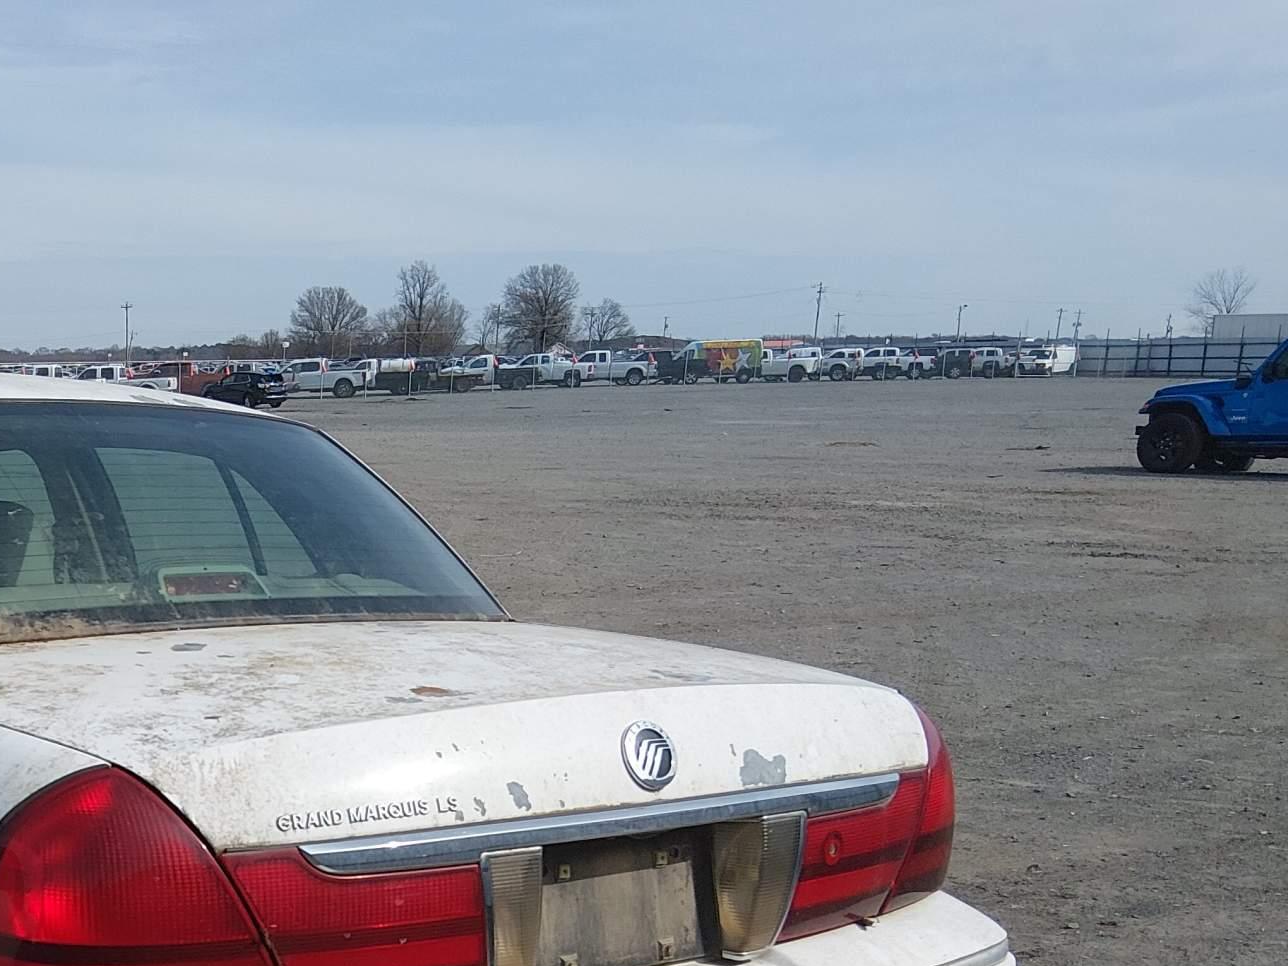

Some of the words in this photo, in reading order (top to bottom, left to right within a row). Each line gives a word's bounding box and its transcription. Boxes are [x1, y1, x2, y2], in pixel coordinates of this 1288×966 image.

[275, 809, 343, 832] GRAND
[346, 799, 429, 824] MARQUIS
[435, 796, 458, 814] LS
